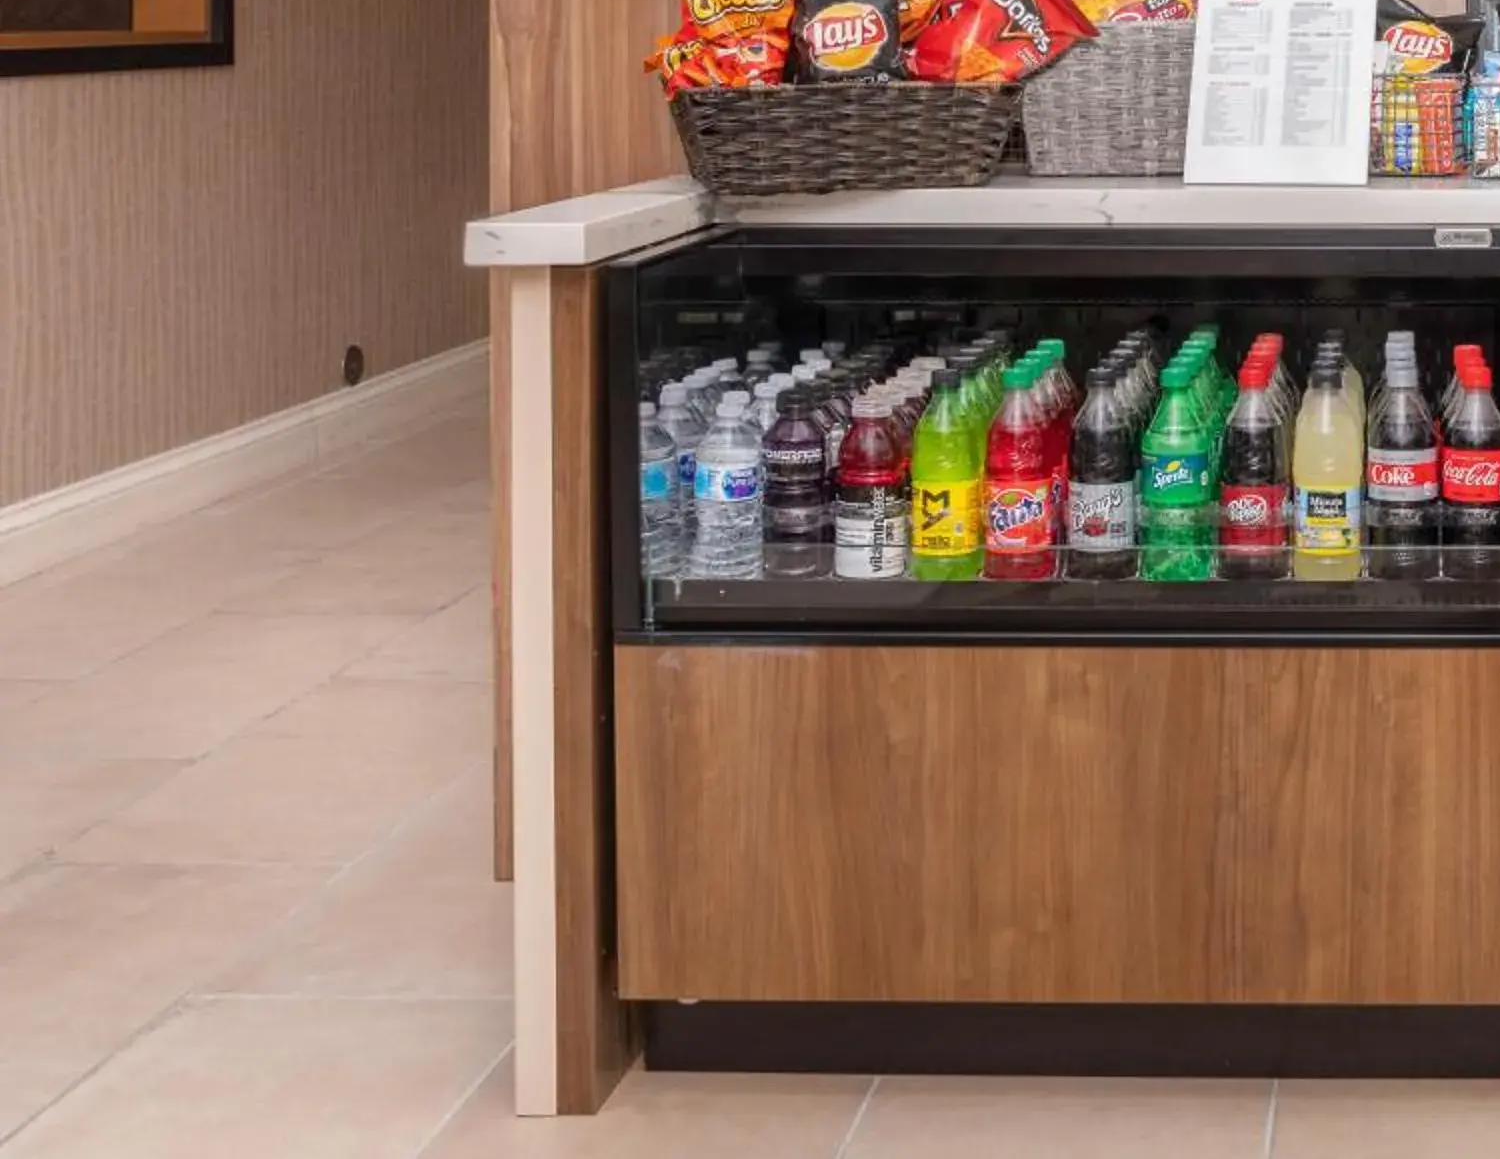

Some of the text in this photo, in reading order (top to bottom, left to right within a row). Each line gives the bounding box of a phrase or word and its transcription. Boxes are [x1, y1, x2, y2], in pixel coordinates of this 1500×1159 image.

[1153, 467, 1194, 489] Sprite
[1371, 463, 1416, 486] Coke
[989, 496, 1045, 532] Fanta
